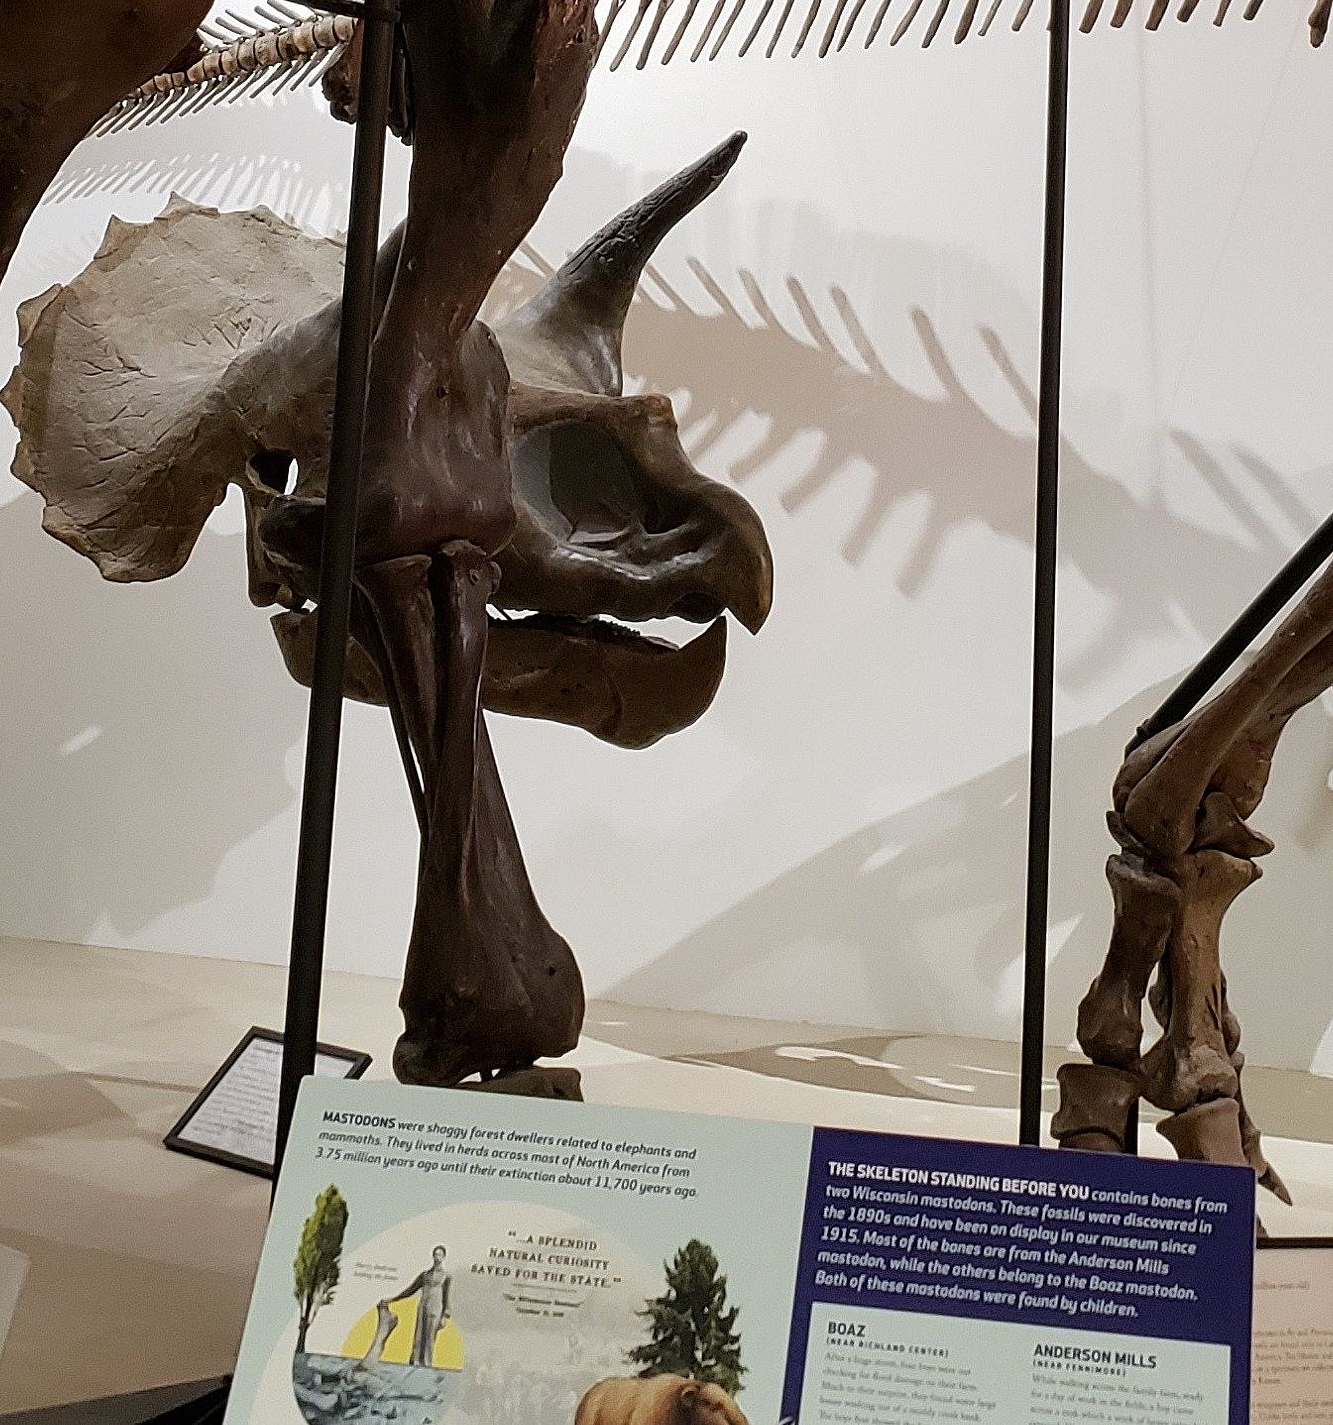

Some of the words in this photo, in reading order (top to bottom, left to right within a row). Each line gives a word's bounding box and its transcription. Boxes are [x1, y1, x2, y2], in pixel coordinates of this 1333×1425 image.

[318, 1130, 382, 1146] mammoths.
[386, 1136, 413, 1152] They
[415, 1140, 444, 1152] lived
[445, 1142, 455, 1153] in
[457, 1144, 489, 1157] herds
[491, 1149, 529, 1162] across
[531, 1153, 560, 1165] most
[562, 1154, 575, 1168] of
[576, 1157, 610, 1170] North
[612, 1160, 660, 1174] America
[661, 1164, 690, 1179] from
[322, 1111, 397, 1129] MASTODONS
[398, 1121, 424, 1132] were
[427, 1123, 468, 1139] shaggy
[469, 1126, 504, 1140] forest
[507, 1130, 554, 1145] dwellers
[556, 1137, 599, 1150] related
[601, 1141, 612, 1151] to
[615, 1143, 671, 1157] elephants
[674, 1149, 697, 1160] and
[343, 1151, 381, 1165] million
[383, 1156, 415, 1169] years
[417, 1160, 438, 1173] ago
[440, 1162, 467, 1174] until
[469, 1164, 496, 1176] their
[499, 1168, 555, 1183] extinction
[558, 1174, 592, 1187] about
[595, 1176, 638, 1191] 11,700
[639, 1183, 671, 1195] years
[828, 1161, 856, 1177] THE
[857, 1164, 928, 1185] SKELETON
[931, 1171, 1000, 1192] STANDING
[1002, 1178, 1057, 1197] BEFORE
[1059, 1184, 1090, 1200] YOU
[1091, 1189, 1149, 1206] contains
[1151, 1193, 1192, 1210] bones
[1194, 1196, 1228, 1214] from
[823, 1205, 845, 1220] the
[848, 1207, 891, 1225] 1890s
[893, 1213, 920, 1227] and
[921, 1214, 953, 1231] have
[955, 1218, 988, 1235] been
[990, 1223, 1007, 1237] on
[1009, 1224, 1058, 1245] display
[1060, 1228, 1075, 1242] in
[1076, 1232, 1099, 1245] our
[1101, 1234, 1159, 1251] museum
[1161, 1239, 1197, 1255] since
[825, 1184, 850, 1199] two
[852, 1185, 918, 1205] Wisconsin
[920, 1195, 997, 1214] mastodons.
[1000, 1200, 1039, 1218] These
[1041, 1204, 1086, 1222] fossils
[1088, 1211, 1121, 1225] were
[1123, 1212, 1198, 1232] discovered
[1199, 1219, 1213, 1234] in
[489, 1248, 544, 1264] NATURAL
[548, 1255, 610, 1270] CURIOSITY
[538, 1235, 597, 1251] SPLENDID
[820, 1226, 860, 1244] 1915.
[862, 1230, 898, 1248] Most
[899, 1234, 915, 1252] of
[917, 1236, 939, 1252] the
[941, 1239, 981, 1256] bones
[983, 1247, 1007, 1259] are
[1008, 1245, 1042, 1262] from
[1044, 1249, 1067, 1264] the
[1068, 1251, 1133, 1272] Anderson
[1136, 1257, 1170, 1275] Mills
[471, 1264, 511, 1276] SAVED
[515, 1269, 538, 1279] FOR
[543, 1272, 566, 1282] THE
[815, 1269, 848, 1287] Both
[849, 1273, 866, 1292] of
[867, 1276, 905, 1293] these
[906, 1283, 981, 1302] mastodons
[983, 1291, 1017, 1305] were
[1018, 1291, 1059, 1310] found
[1060, 1296, 1078, 1315] by
[1080, 1300, 1139, 1317] children.
[817, 1250, 887, 1270] mastodon,
[890, 1257, 925, 1273] while
[927, 1260, 950, 1275] the
[952, 1263, 996, 1281] others
[998, 1266, 1044, 1288] belong
[1047, 1273, 1061, 1287] to
[1064, 1275, 1087, 1290] the
[1089, 1276, 1124, 1292] Boaz
[1126, 1284, 1198, 1301] mastodon.
[828, 1321, 866, 1337] BOAZ
[1035, 1343, 1111, 1363] ANDERSON
[1115, 1352, 1157, 1369] MILLS
